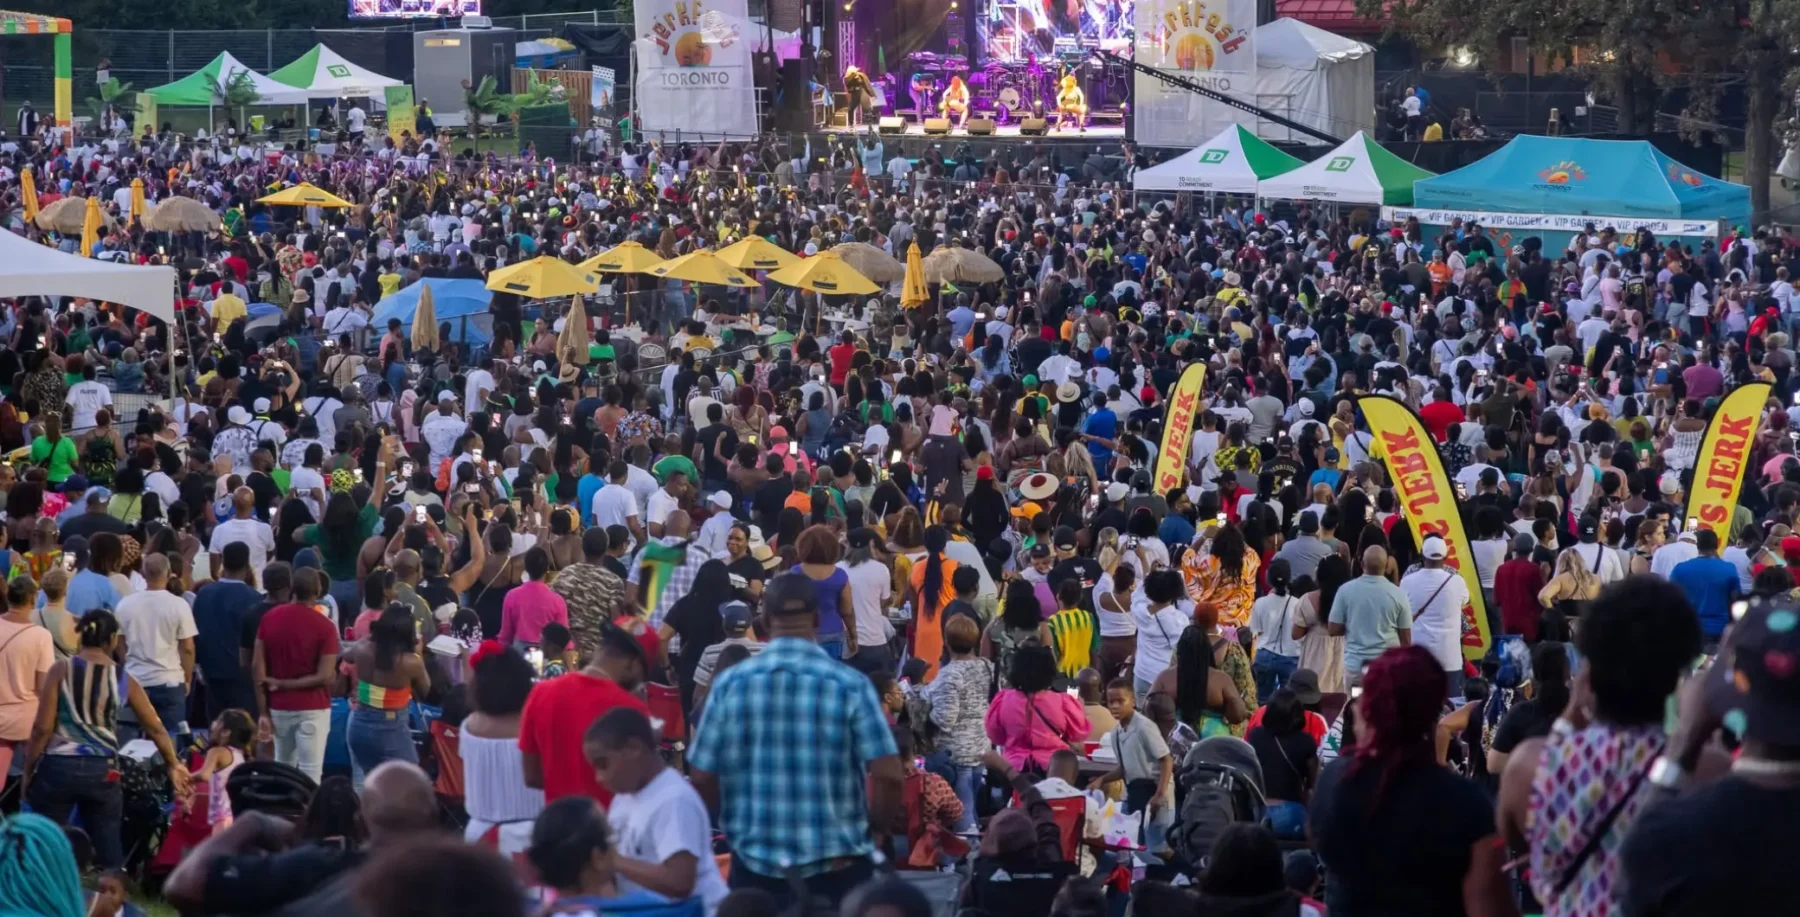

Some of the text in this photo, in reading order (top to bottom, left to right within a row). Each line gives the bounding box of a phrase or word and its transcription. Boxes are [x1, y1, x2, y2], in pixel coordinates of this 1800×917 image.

[329, 66, 349, 76] TD
[661, 72, 729, 85] TORONTO
[1204, 151, 1226, 162] TD
[1330, 158, 1352, 170] TD
[1428, 212, 1668, 231] VIP GARDEN VIP GARDEN VIP GARDEN VIP GARDEN
[1166, 387, 1195, 469] JERK
[1706, 413, 1753, 499] JERK
